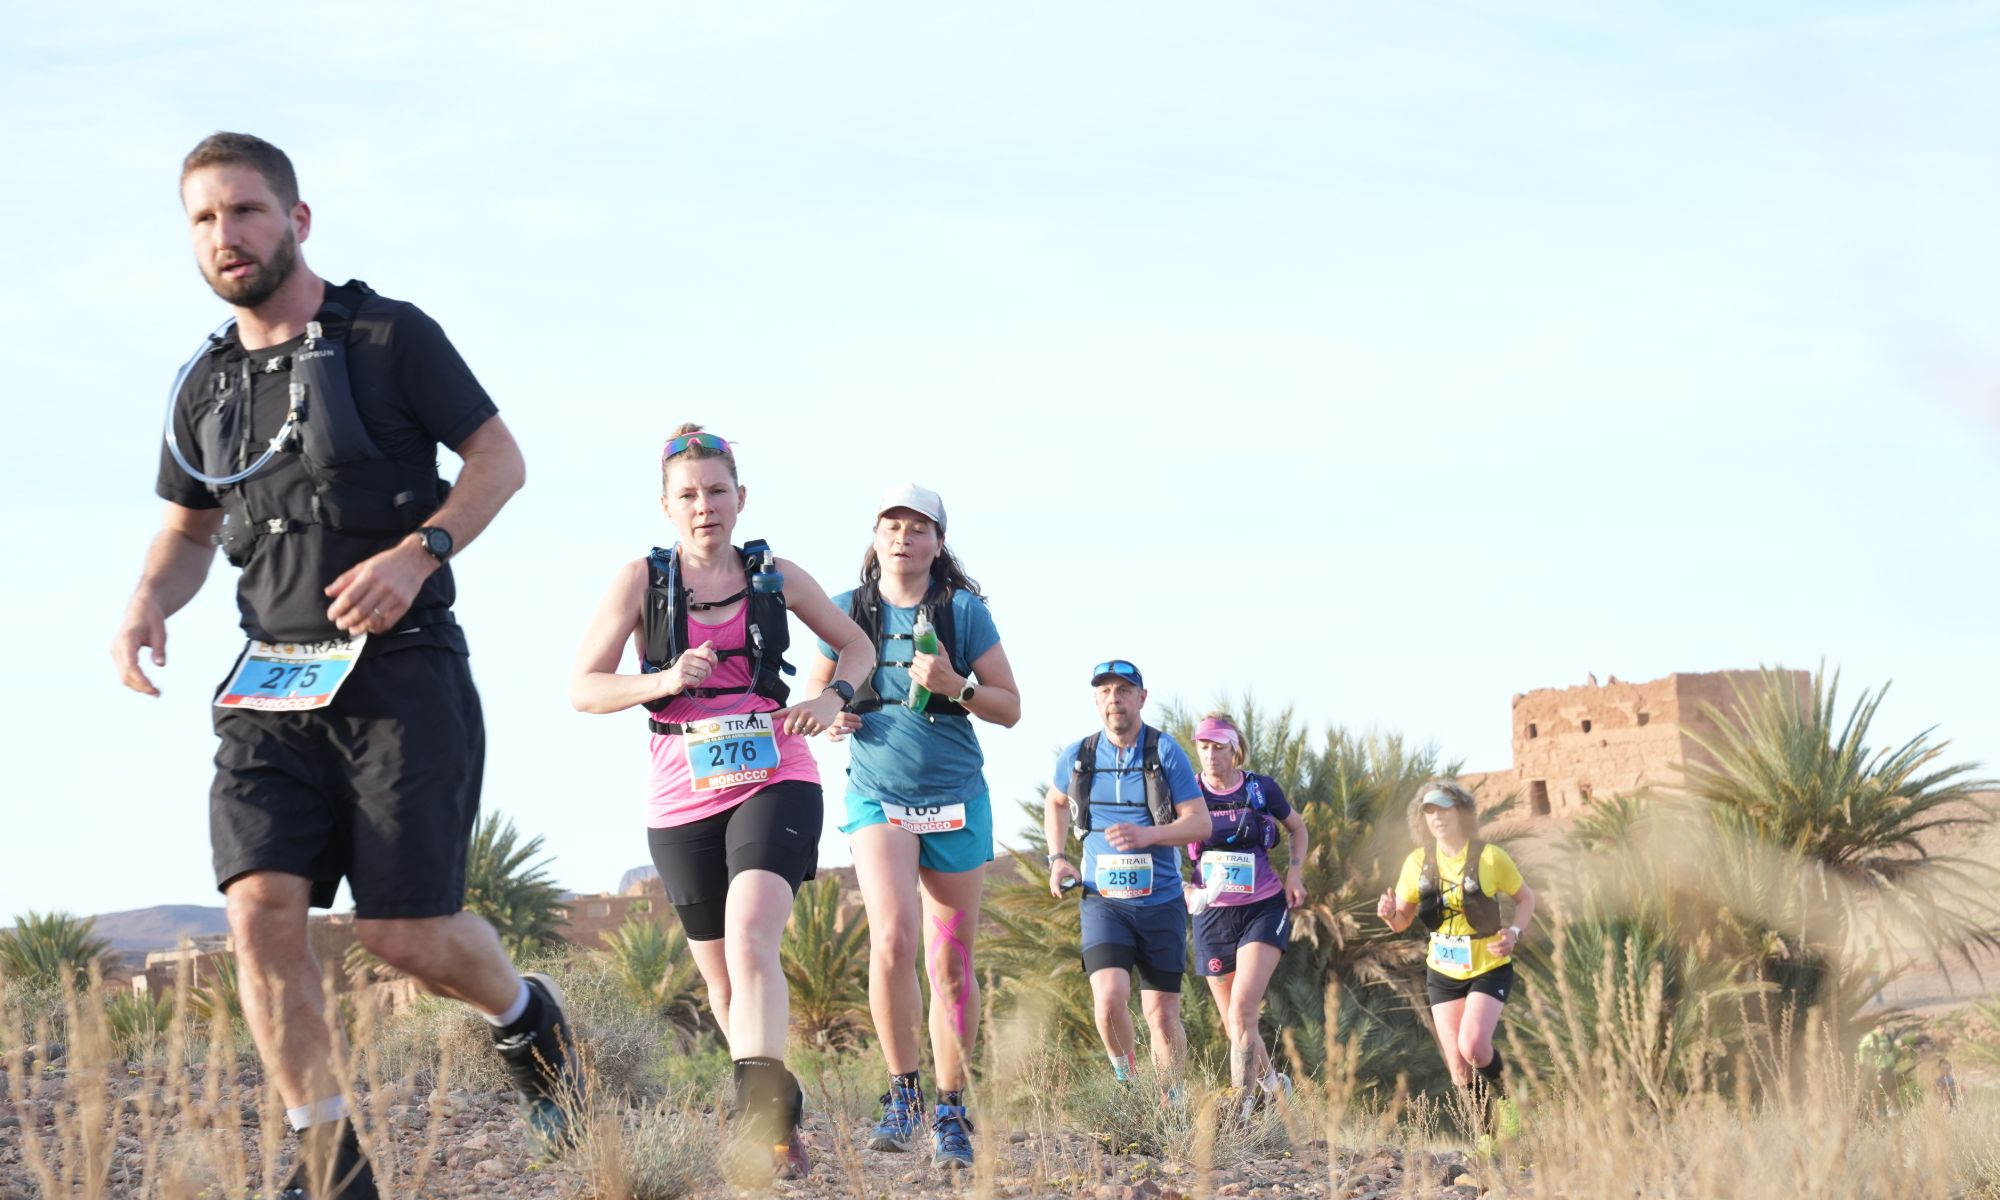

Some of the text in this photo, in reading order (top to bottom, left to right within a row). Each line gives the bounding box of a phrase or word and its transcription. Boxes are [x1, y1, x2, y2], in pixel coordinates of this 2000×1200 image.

[301, 640, 354, 655] TRAL
[260, 664, 321, 689] 275
[239, 696, 317, 709] MOROCCO
[724, 719, 768, 732] TRAIL
[709, 740, 757, 767] 276
[709, 769, 768, 788] MOROCCO
[901, 820, 952, 832] MOROCCO
[1225, 855, 1251, 863] TRAIL
[1109, 872, 1138, 885] 258
[1442, 947, 1455, 959] 21
